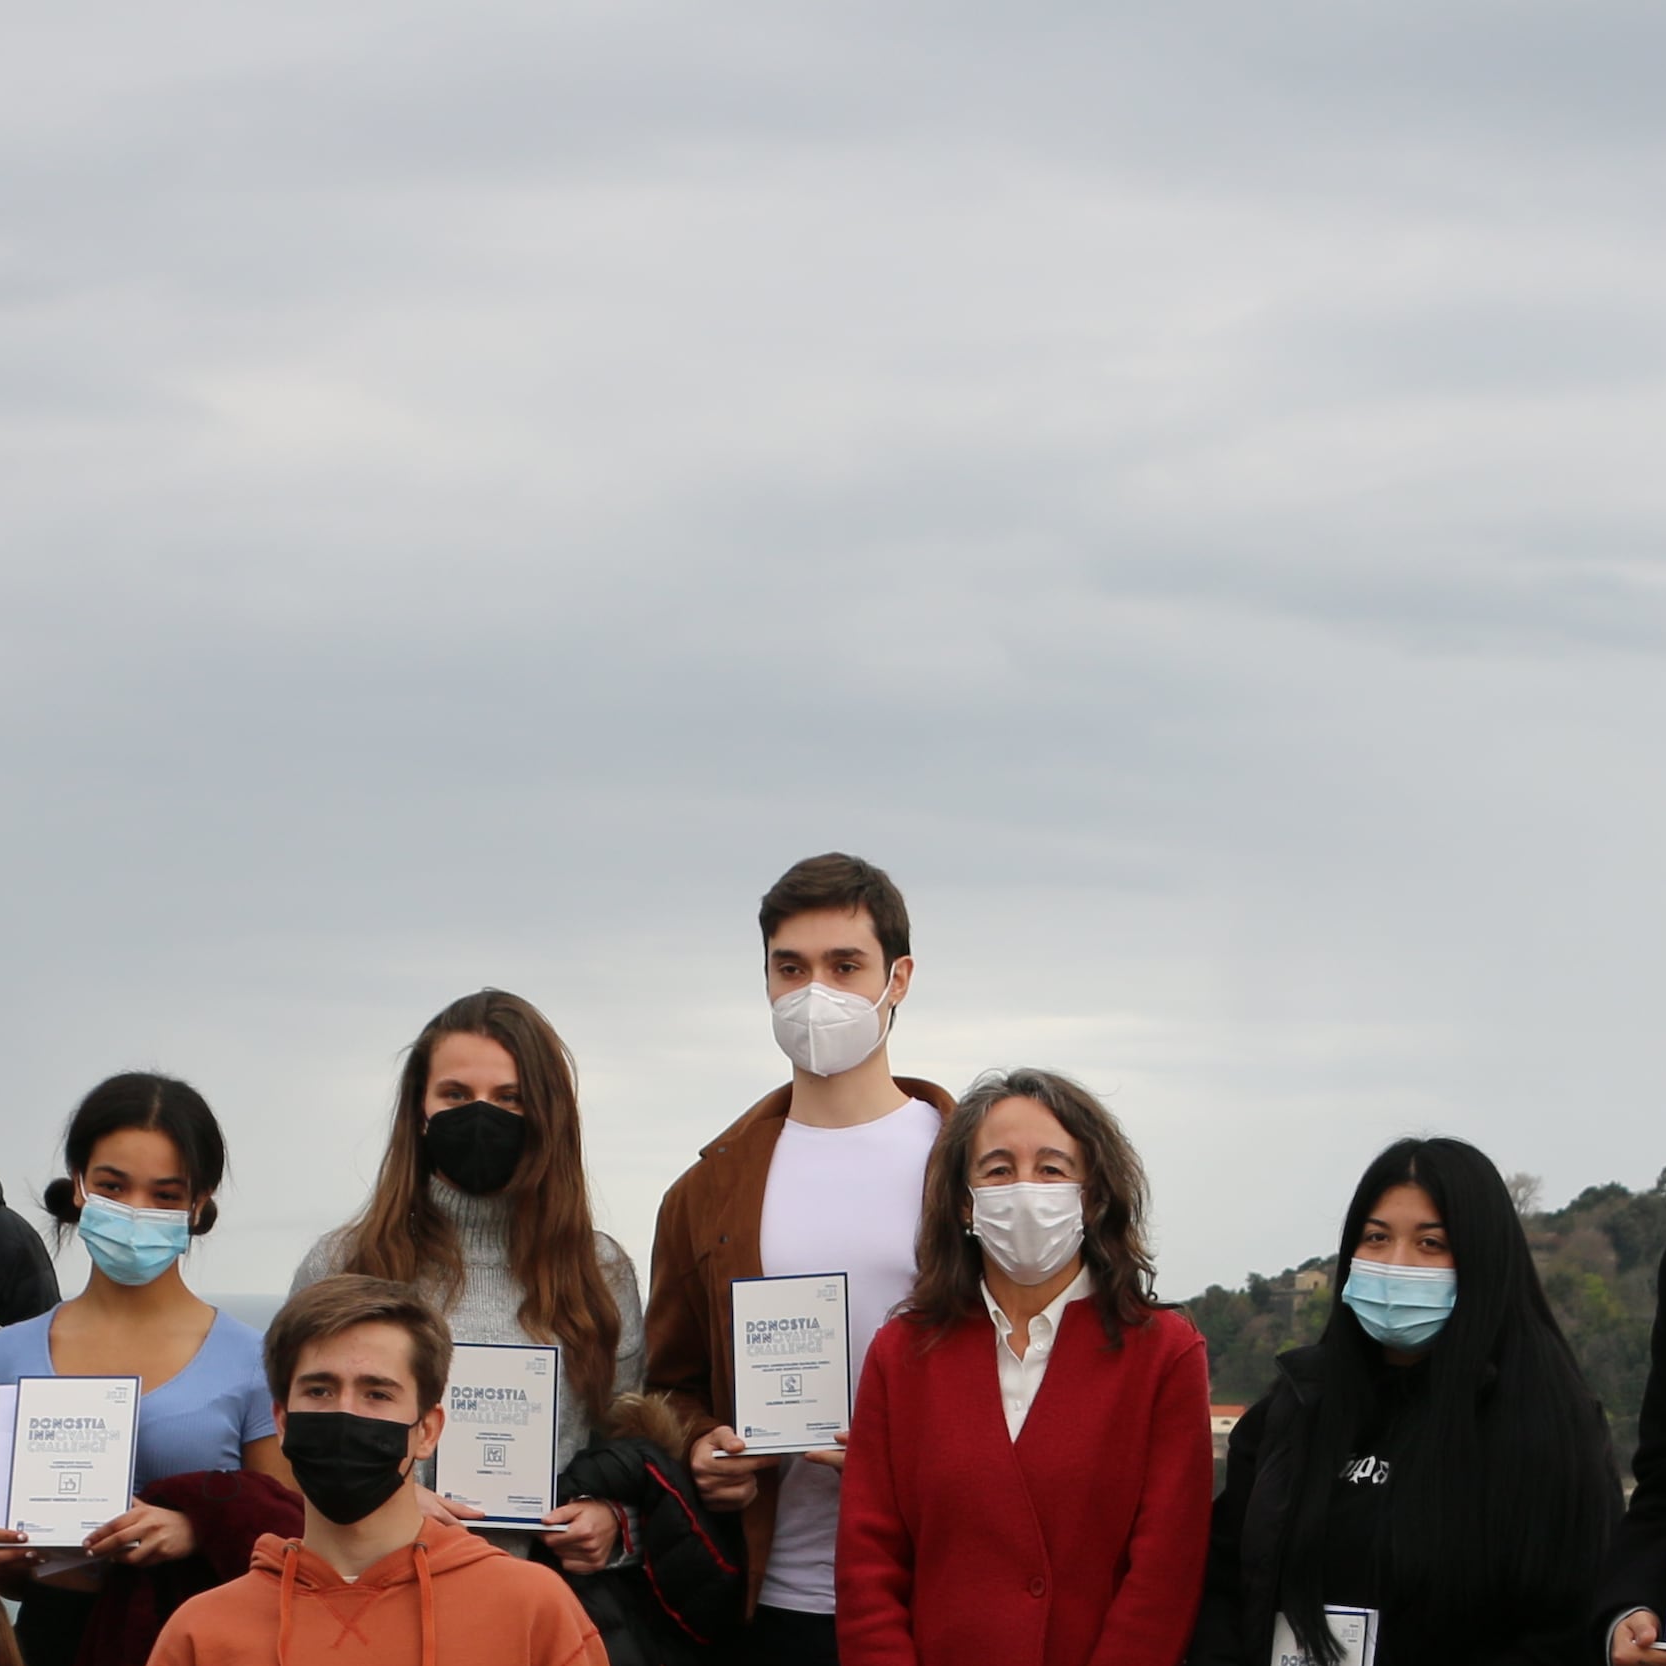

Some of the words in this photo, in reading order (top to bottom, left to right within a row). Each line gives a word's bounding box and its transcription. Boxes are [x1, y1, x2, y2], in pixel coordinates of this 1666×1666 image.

[746, 1317, 820, 1333] DONOSTIA
[746, 1328, 835, 1344] INNOVATION
[747, 1340, 822, 1356] CHALLENGE
[451, 1386, 527, 1401] DONOSTIA
[451, 1399, 541, 1414] INNOVATION
[30, 1418, 106, 1429] DONOSTIA
[451, 1411, 529, 1425] CHALLENGE
[29, 1430, 120, 1441] INNOVATION
[28, 1441, 106, 1452] CHALLENGE
